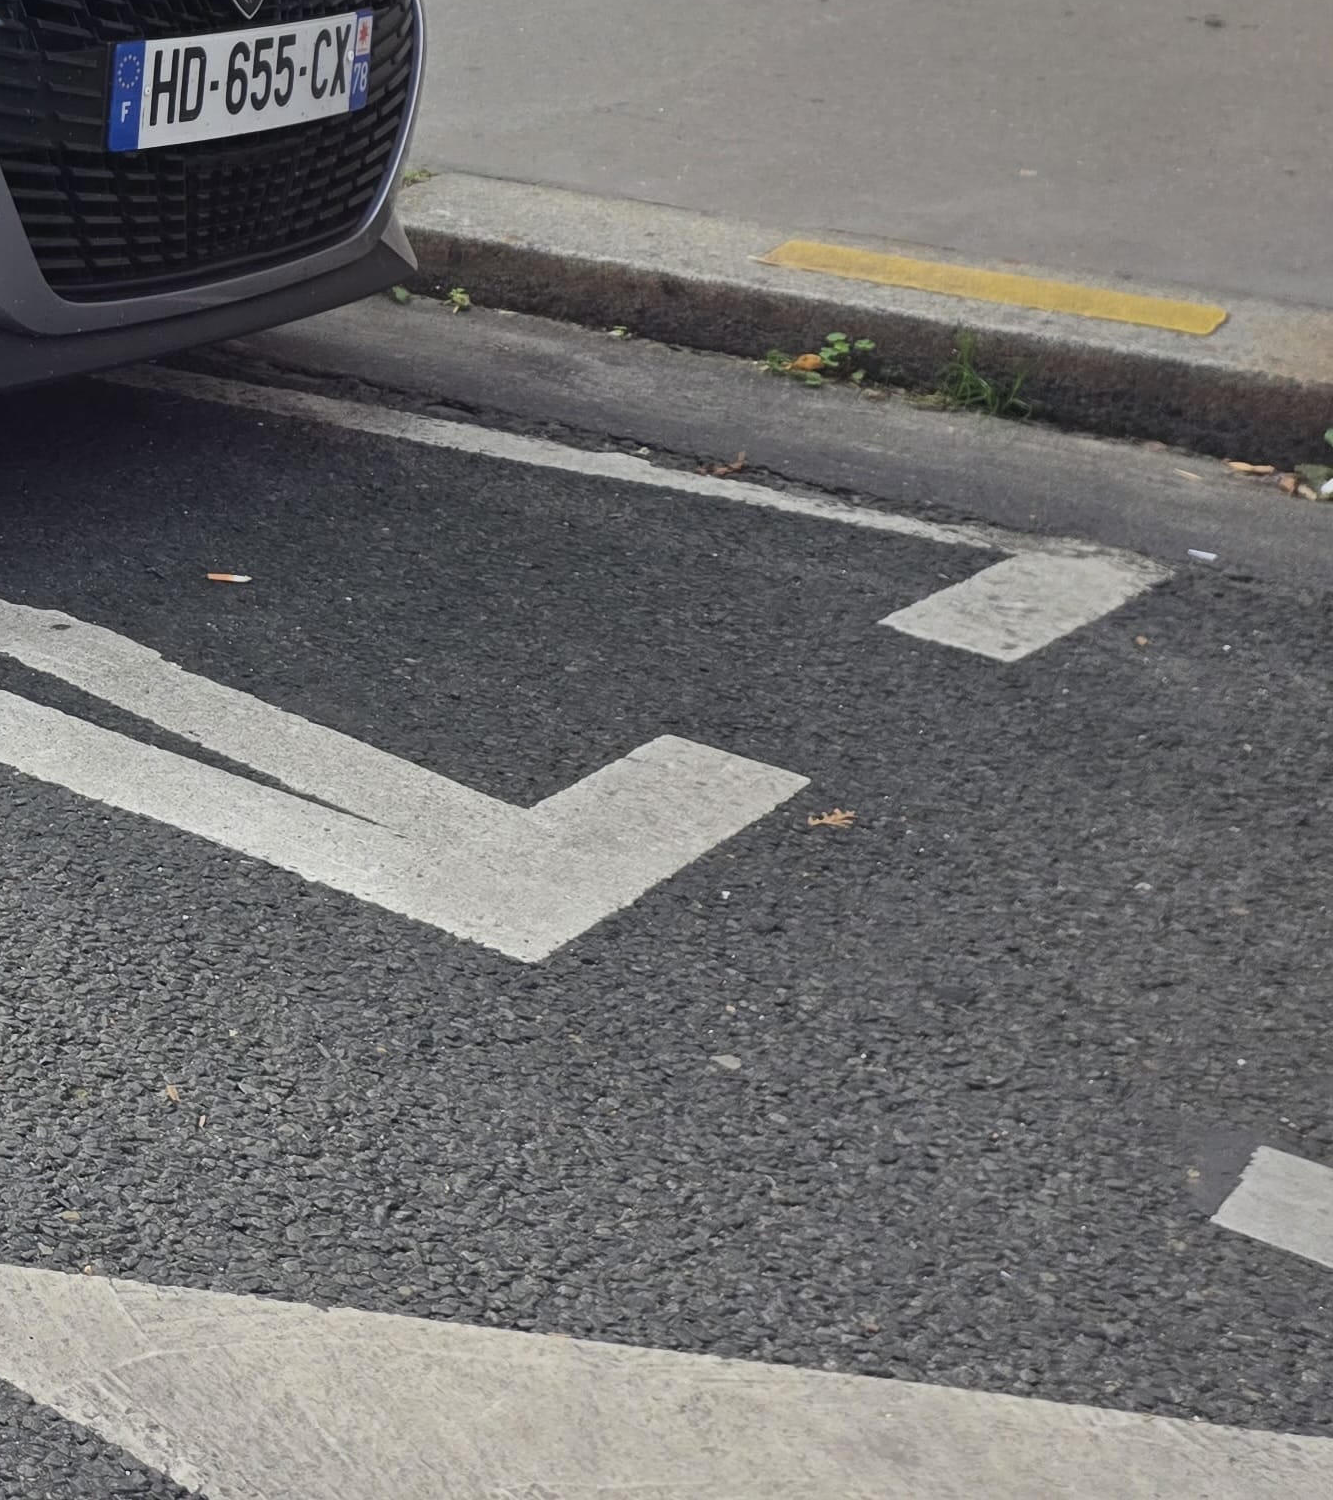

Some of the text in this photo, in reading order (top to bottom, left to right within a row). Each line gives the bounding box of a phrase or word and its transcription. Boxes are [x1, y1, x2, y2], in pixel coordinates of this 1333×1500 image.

[120, 23, 369, 127] F HD-655-CX 78
